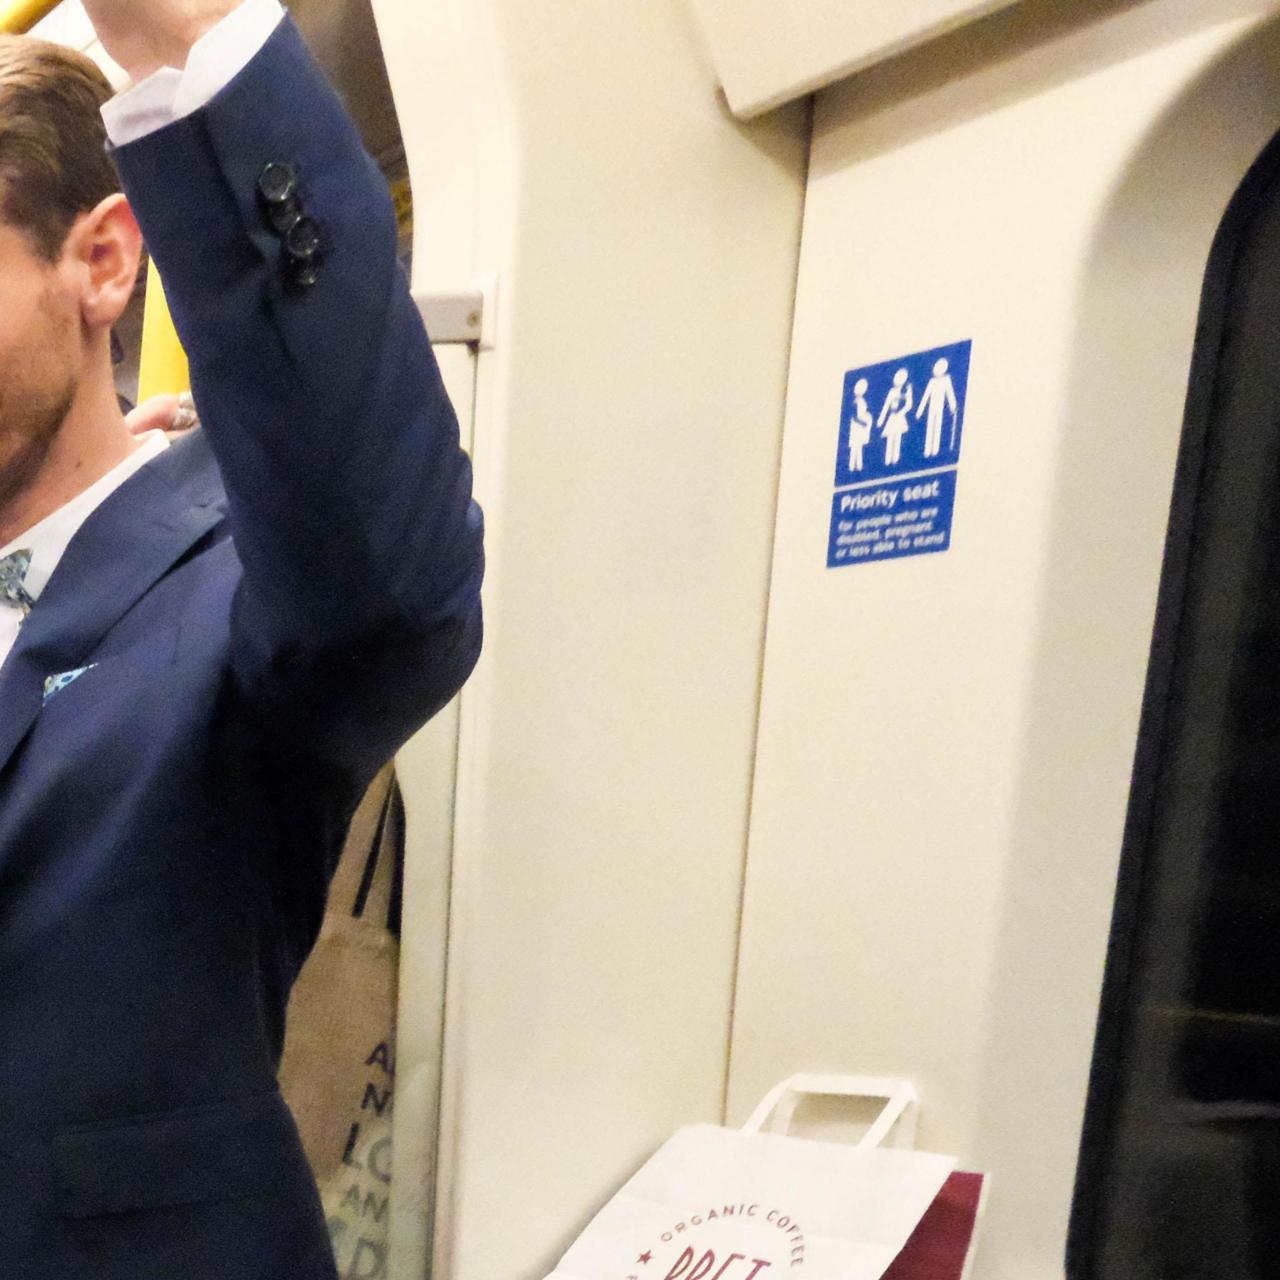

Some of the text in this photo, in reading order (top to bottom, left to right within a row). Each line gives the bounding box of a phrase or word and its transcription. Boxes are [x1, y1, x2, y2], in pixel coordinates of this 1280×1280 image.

[840, 480, 940, 513] Priority seat
[838, 507, 939, 532] for people who are
[885, 521, 933, 540] pregnant
[849, 544, 870, 556] less
[873, 540, 895, 554] able
[897, 539, 911, 550] to
[913, 532, 945, 547] stand
[660, 1204, 805, 1268] ORGANIC COFFEE
